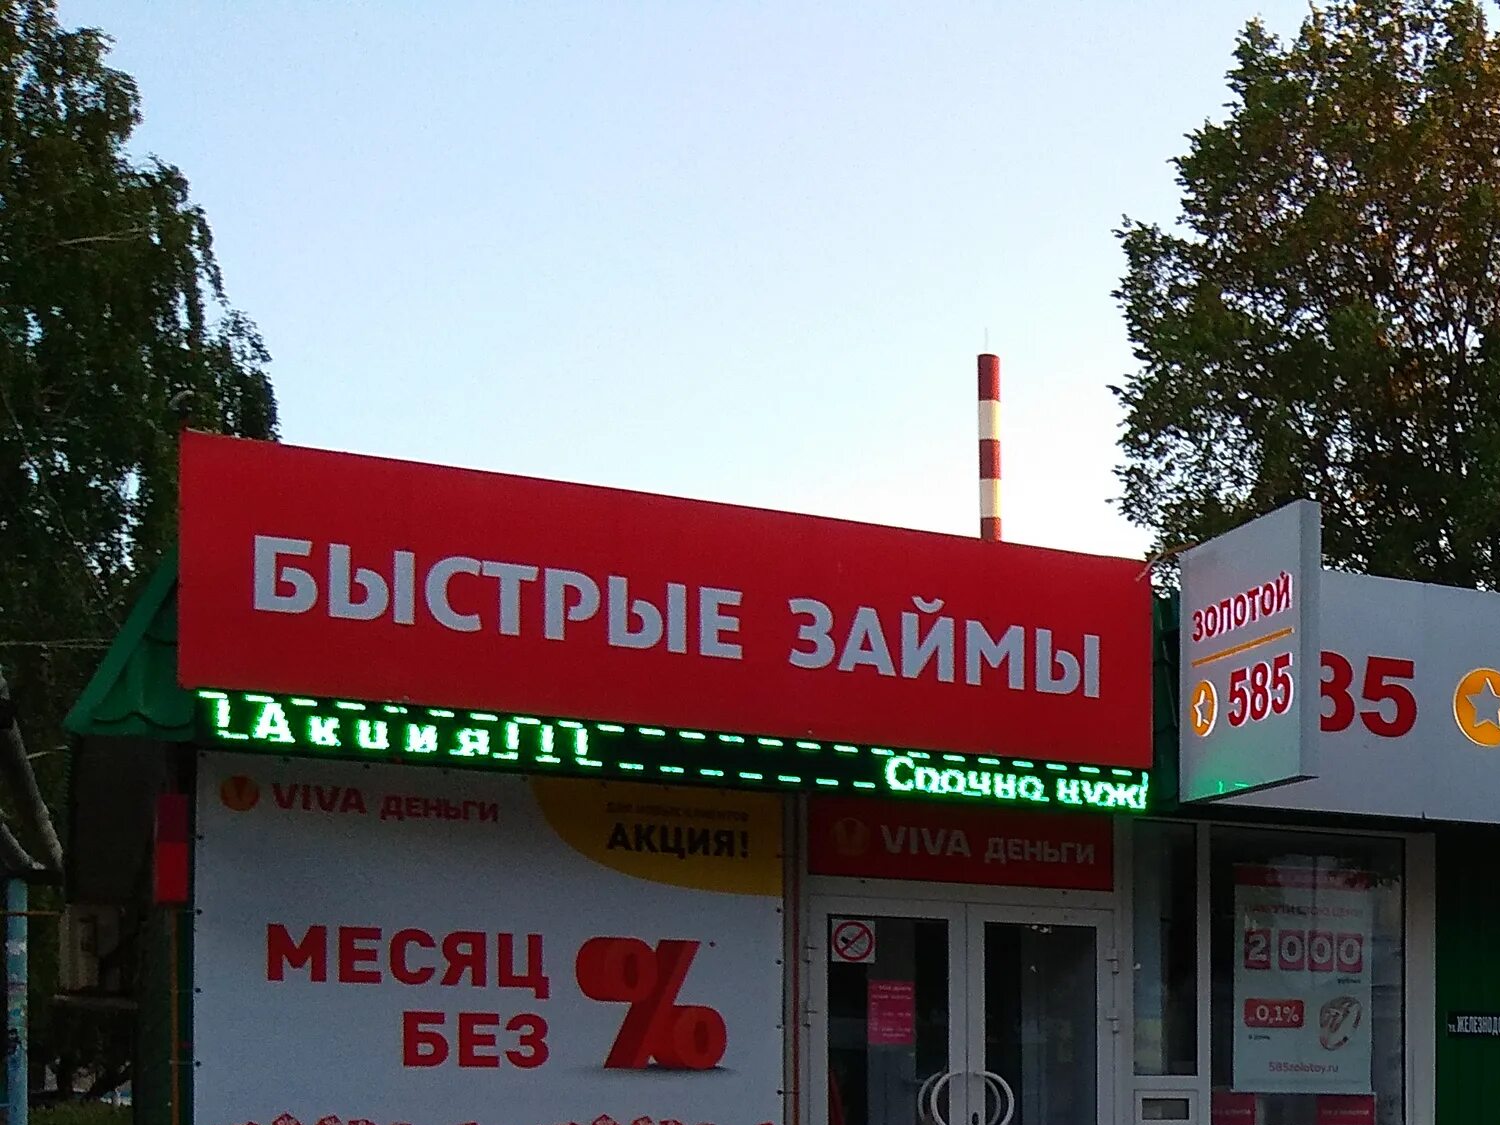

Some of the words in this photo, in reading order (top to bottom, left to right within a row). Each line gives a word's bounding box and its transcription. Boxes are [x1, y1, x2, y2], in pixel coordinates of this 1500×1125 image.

[253, 535, 743, 660] БЫСТРЫЕ
[788, 595, 1100, 699] ЗАЙМЫ
[1192, 571, 1293, 642] ЗОЛОТОЙ
[1228, 652, 1293, 727] 585
[272, 783, 366, 815] VIVA
[607, 822, 748, 859] АКЦИЯ!
[882, 825, 970, 857] VIVA
[266, 923, 549, 999] МЕСЯЦ
[1249, 935, 1361, 965] 2000
[1256, 1006, 1300, 1024] 0,1%
[403, 1011, 549, 1068] БЕЗ
[1268, 1061, 1339, 1075] 585zolotoy.ru
